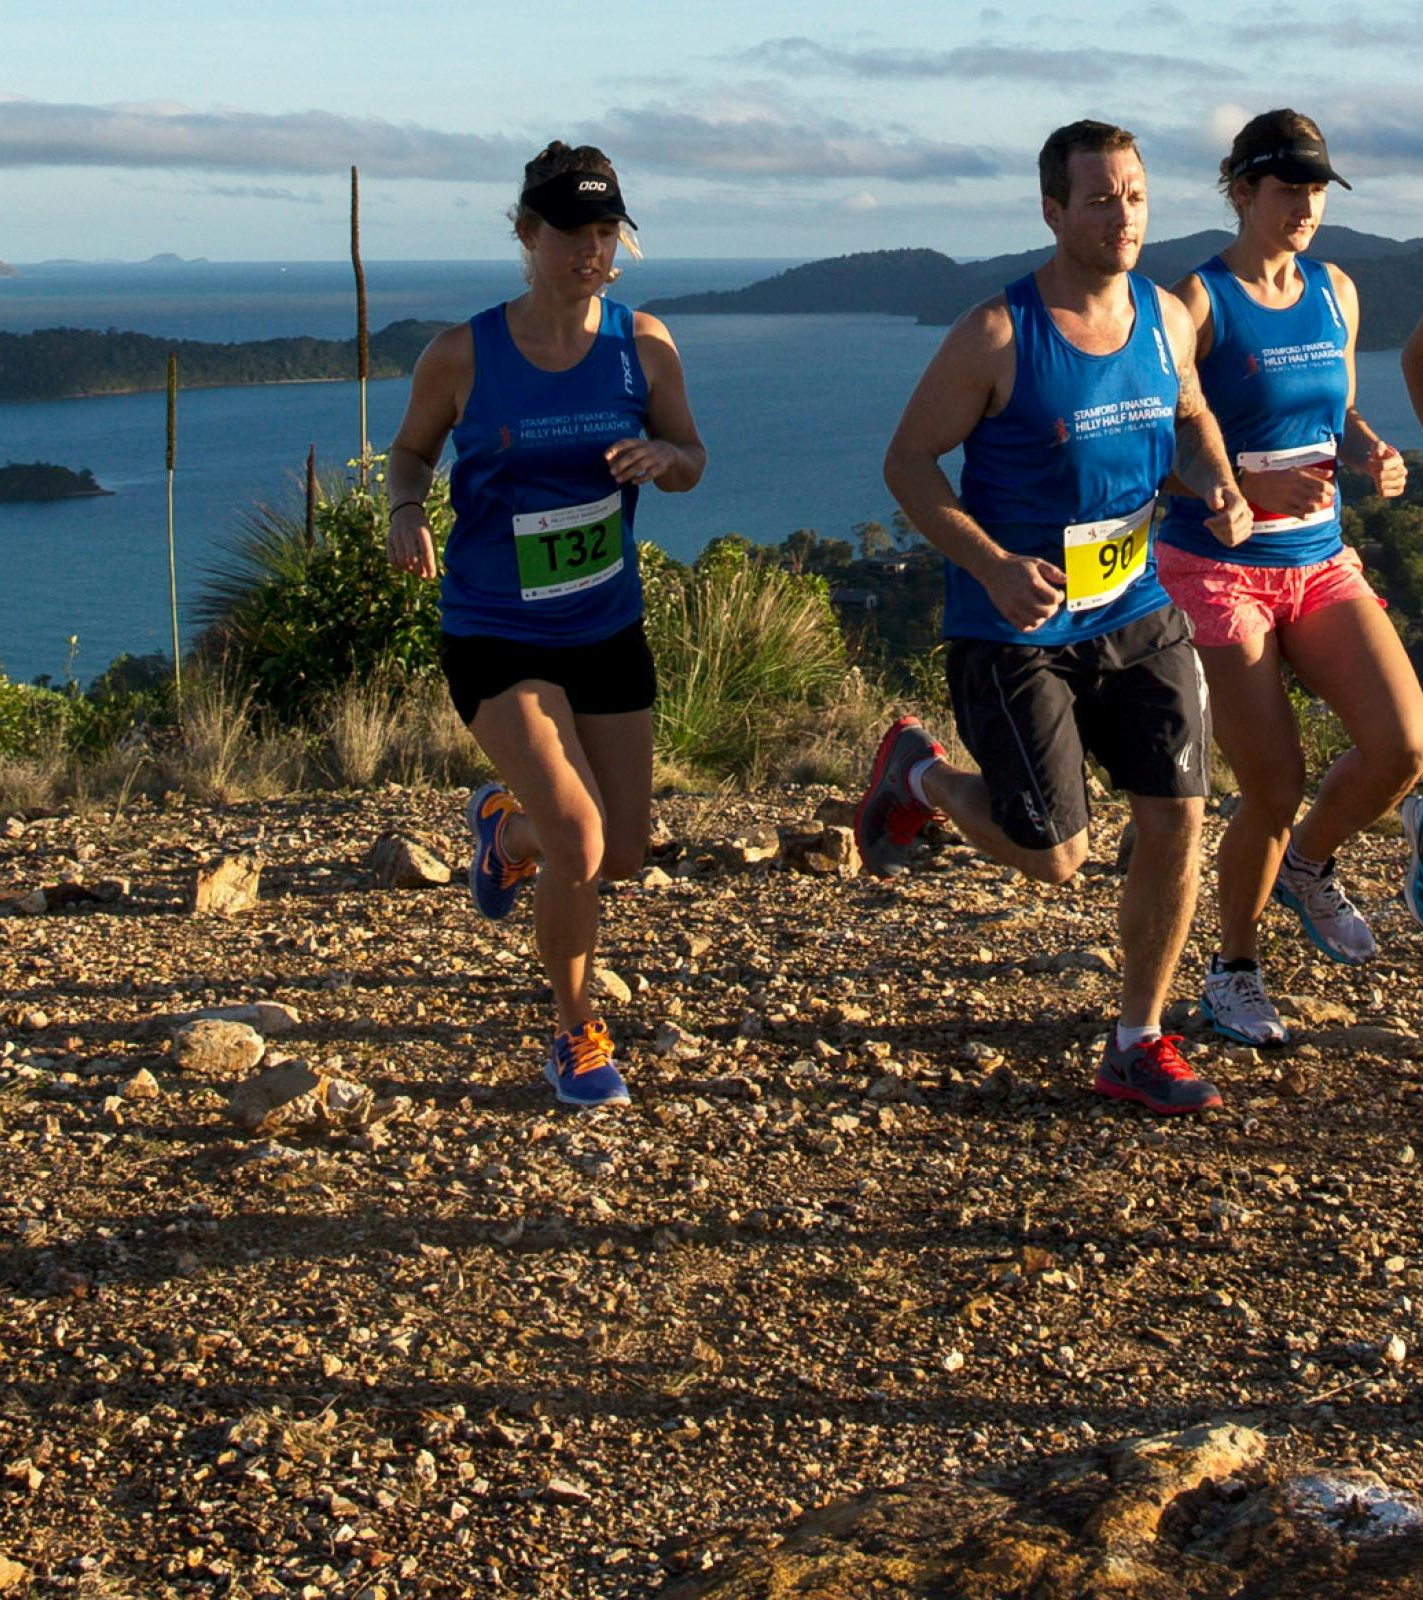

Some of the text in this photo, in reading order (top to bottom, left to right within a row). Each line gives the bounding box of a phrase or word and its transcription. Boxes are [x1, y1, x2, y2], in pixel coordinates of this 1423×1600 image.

[1262, 346, 1301, 357] STAMFORD
[1264, 349, 1344, 367] HILLY HALF MARATHO
[1074, 396, 1162, 420] STAMFORD FINANCIAL
[520, 414, 570, 428] STAMFORD
[1076, 418, 1100, 433] HILLY
[1102, 413, 1127, 427] HALF
[520, 427, 549, 440] HILLY
[552, 423, 579, 436] HALF
[539, 524, 607, 571] T32
[1098, 534, 1134, 580] 90
